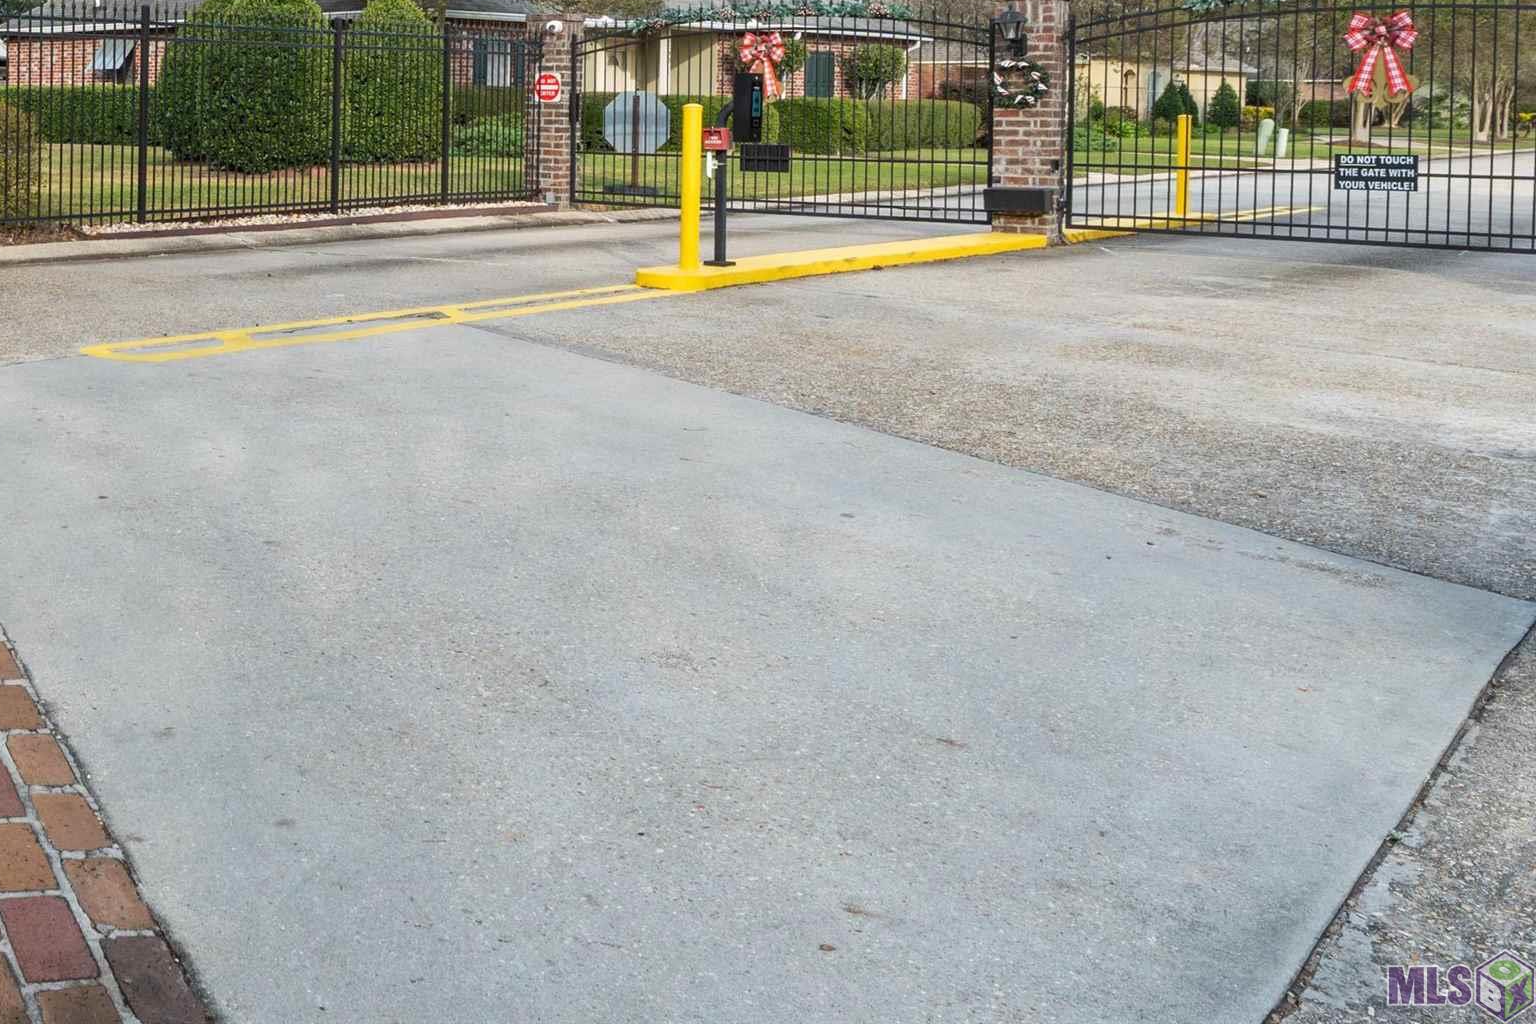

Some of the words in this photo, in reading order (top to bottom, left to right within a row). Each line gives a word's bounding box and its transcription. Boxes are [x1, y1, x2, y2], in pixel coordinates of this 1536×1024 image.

[1340, 156, 1354, 164] DO
[1356, 156, 1377, 164] NOT
[1379, 156, 1414, 165] TOUCH
[1339, 168, 1359, 177] THE
[1360, 168, 1386, 177] GATE
[1388, 169, 1415, 178] WITH
[1339, 180, 1366, 189] YOUR
[1368, 181, 1415, 191] VEHICLE!
